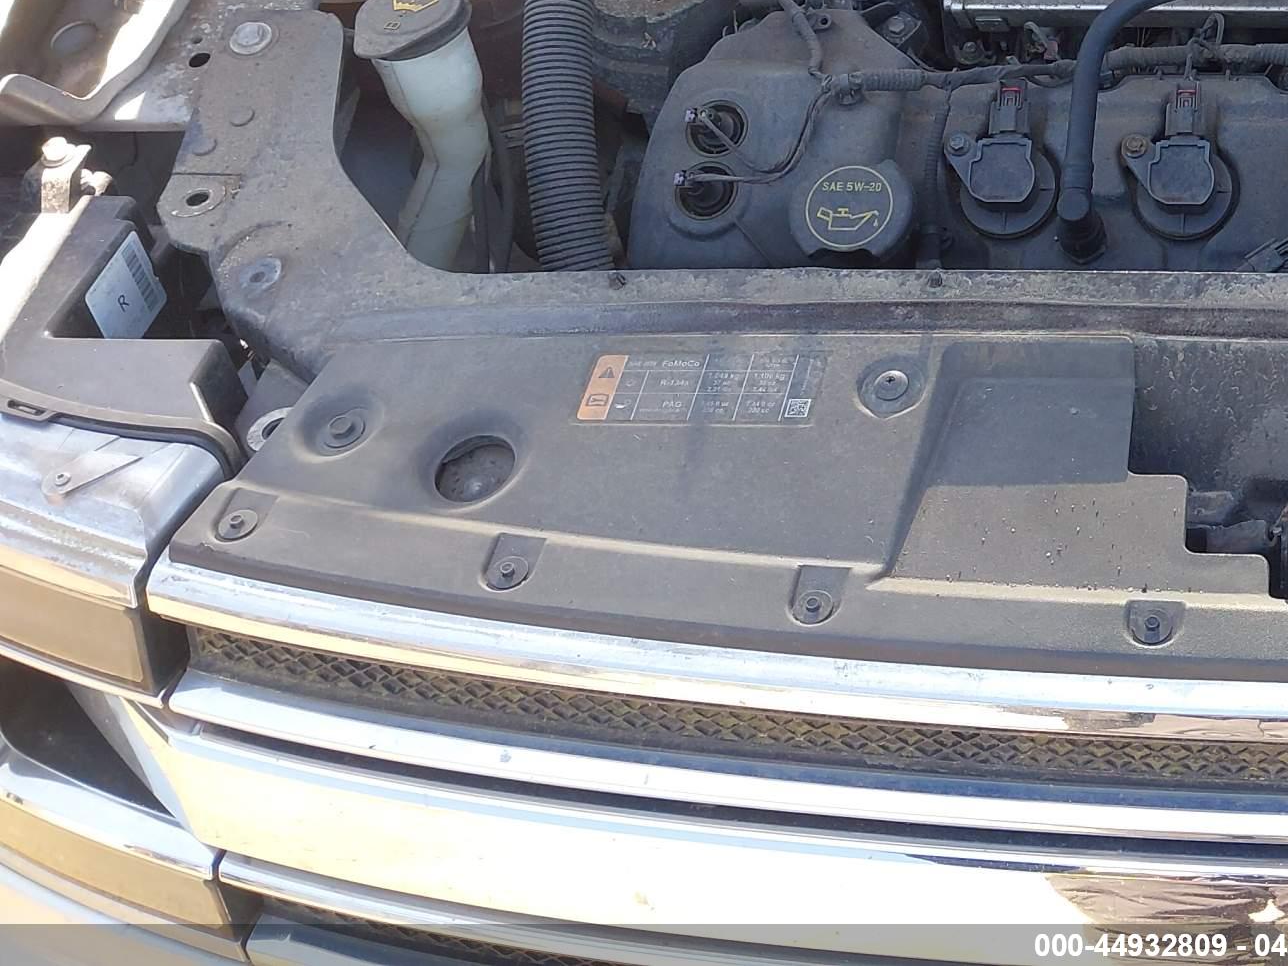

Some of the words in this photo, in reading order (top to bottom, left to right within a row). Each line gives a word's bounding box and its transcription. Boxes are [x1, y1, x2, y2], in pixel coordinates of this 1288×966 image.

[822, 181, 844, 193] SAE
[846, 181, 882, 193] 5W-20
[117, 294, 130, 313] R
[661, 359, 701, 368] FoMoCo
[661, 400, 683, 410] PAG
